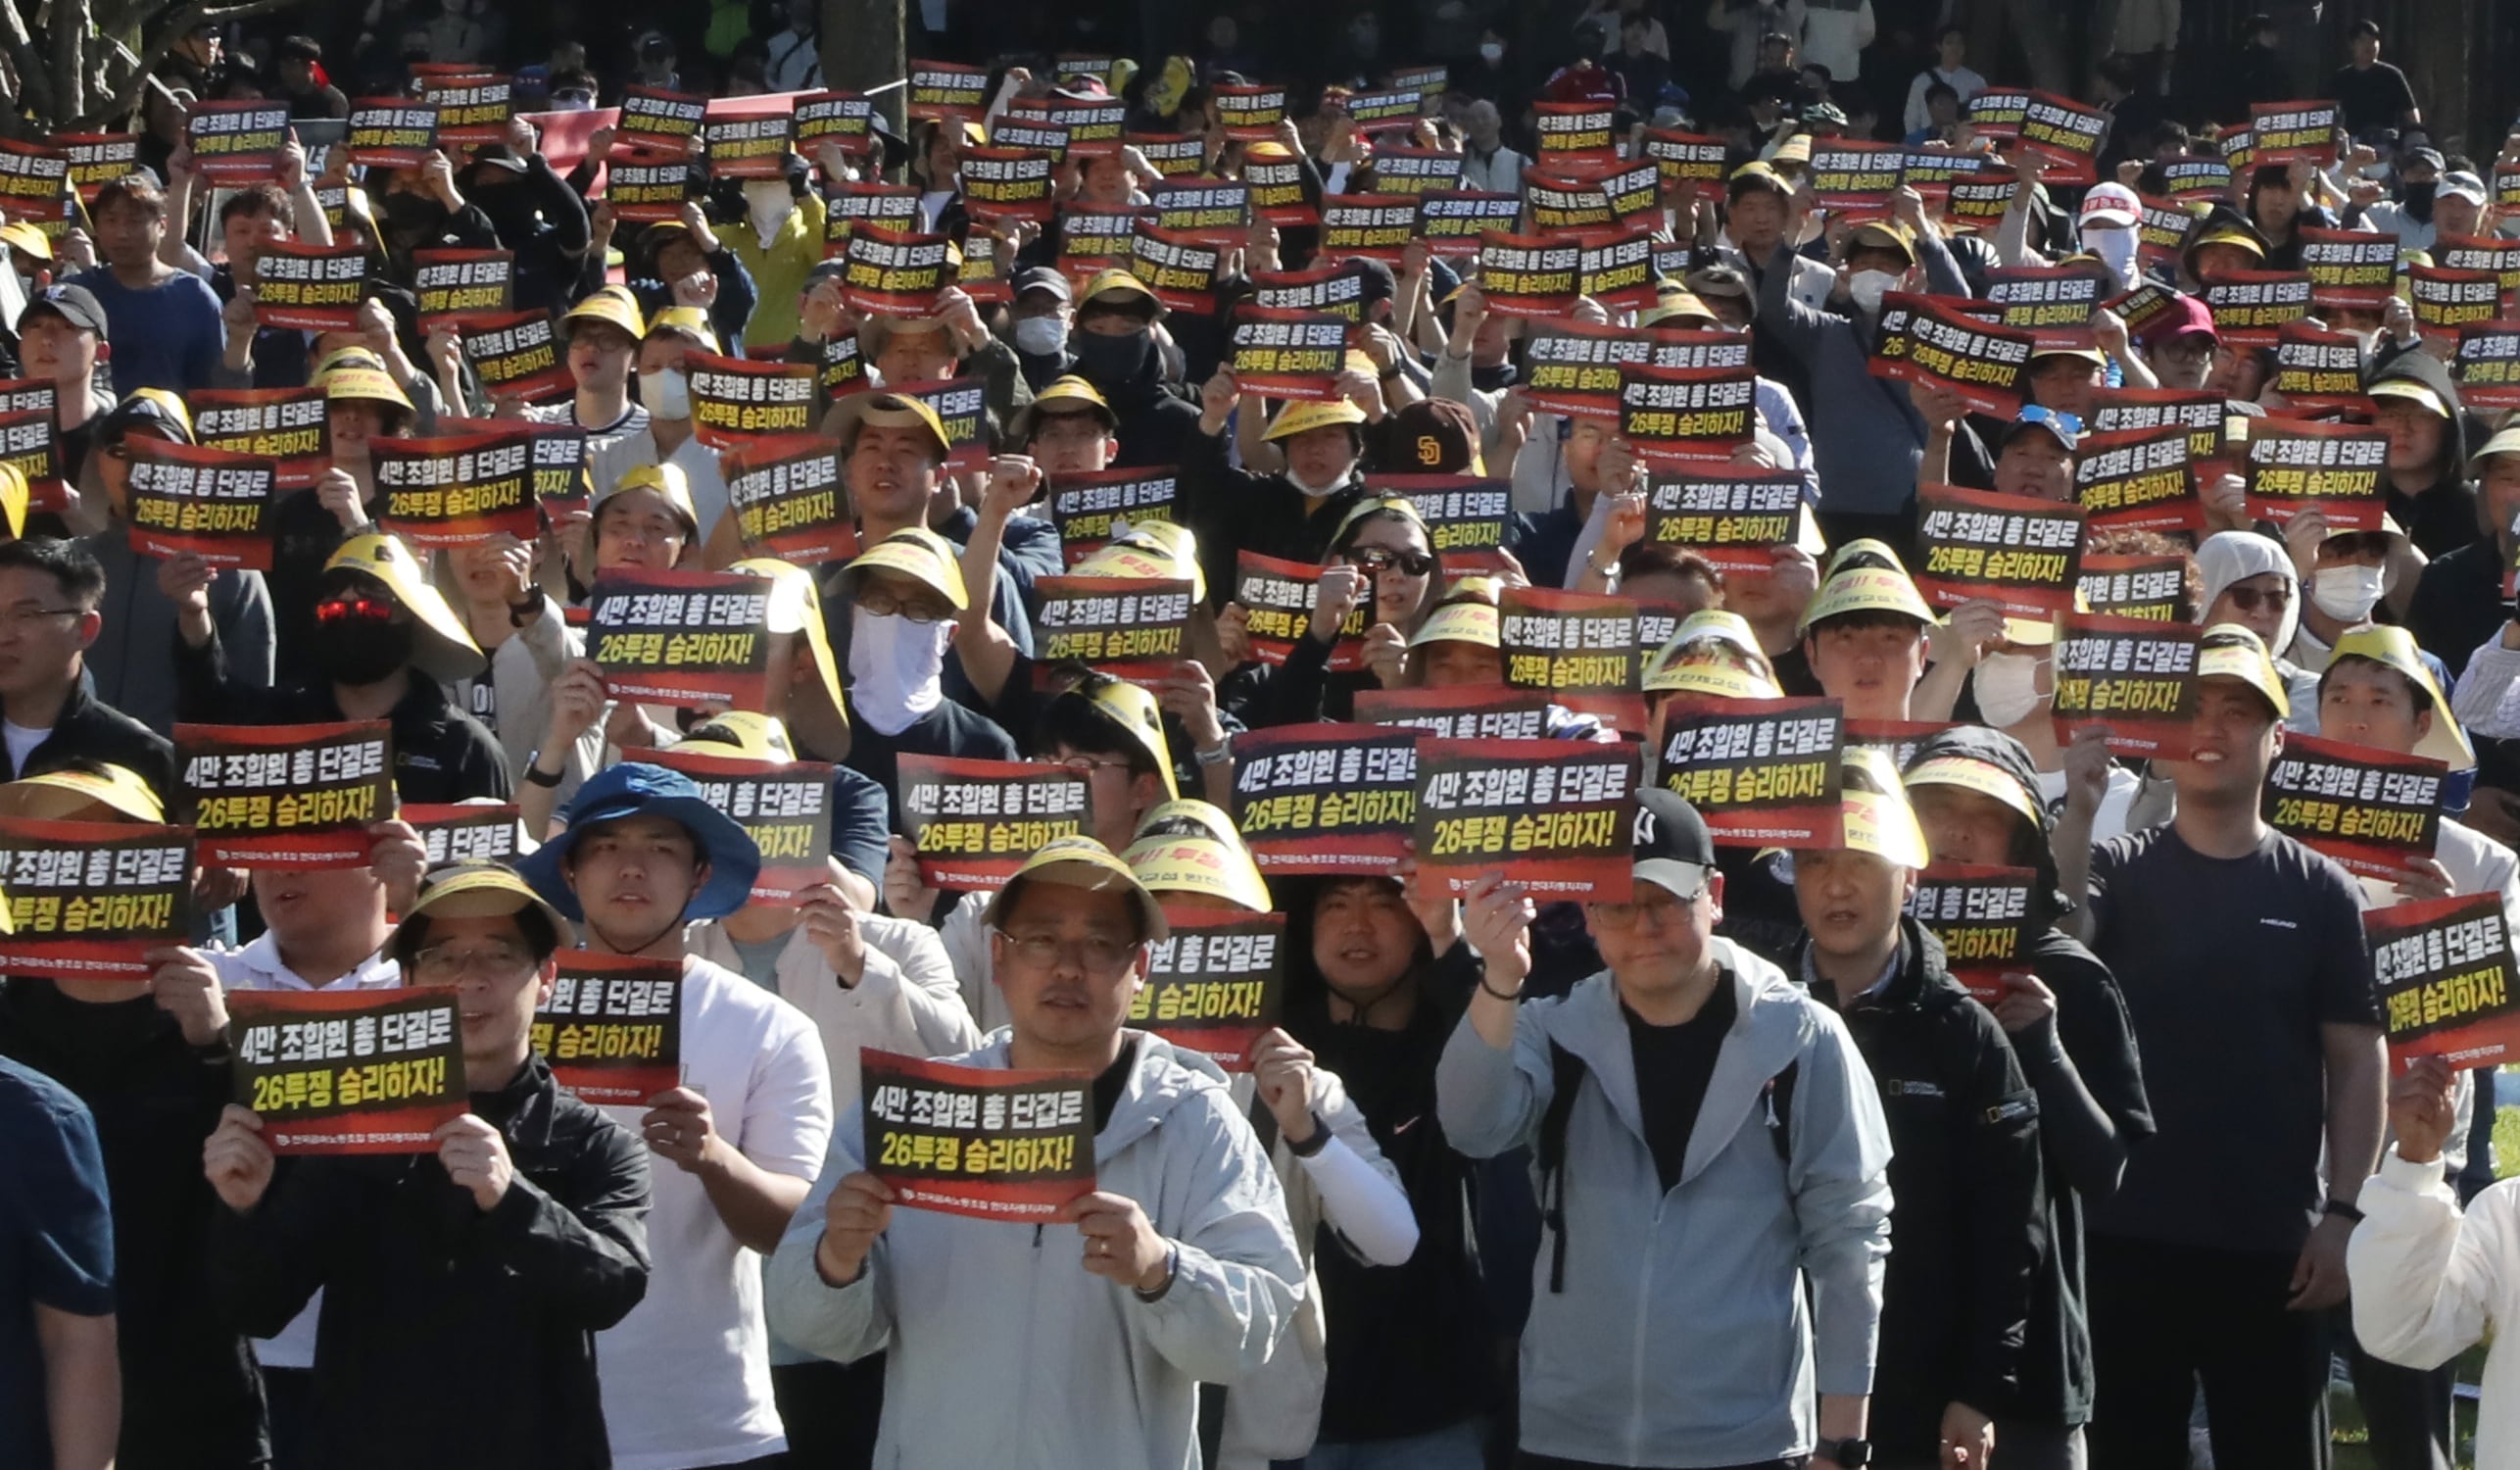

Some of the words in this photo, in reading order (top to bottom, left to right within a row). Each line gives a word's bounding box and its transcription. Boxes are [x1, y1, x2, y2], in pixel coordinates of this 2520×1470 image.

[379, 461, 404, 484] 4만
[407, 458, 454, 485] 조합원
[457, 455, 473, 481] 총
[477, 445, 525, 477] 단결로
[2251, 439, 2276, 463] 4만
[2276, 439, 2321, 465] 조합원
[2321, 440, 2339, 465] 총
[2340, 441, 2385, 465] 단결로
[129, 463, 151, 490] 4만
[152, 465, 195, 494] 조합원
[196, 467, 215, 496] 총
[216, 469, 268, 497] 단결로
[389, 491, 442, 515] 26투쟁
[445, 478, 520, 515] 승리하자!
[1652, 484, 1680, 510] 4만
[1681, 483, 1729, 510] 조합원
[1730, 484, 1749, 510] 총
[1750, 485, 1797, 510] 단결로
[2255, 469, 2305, 494] 26투쟁
[2305, 470, 2376, 495] 승리하자!
[179, 503, 259, 530] 승리하자!
[1657, 516, 1713, 541] 26투쟁
[1715, 515, 1788, 542] 승리하자!
[1923, 511, 1953, 538] 4만
[1952, 513, 2005, 542] 조합원
[2004, 515, 2024, 544] 총
[2024, 518, 2078, 547] 단결로
[1927, 546, 1985, 576] 26투쟁
[1984, 551, 2066, 581] 승리하자!
[596, 596, 629, 625] 4만
[627, 594, 685, 624] 조합원
[685, 594, 707, 625] 총
[708, 594, 766, 624] 단결로
[1040, 600, 1068, 626] 4만
[1069, 597, 1118, 624] 조합원
[1120, 596, 1138, 623] 총
[1139, 594, 1188, 621] 단결로
[596, 634, 663, 663] 26투쟁
[665, 633, 754, 663] 승리하자!
[1045, 632, 1102, 659] 26투쟁
[1106, 627, 1181, 657] 승리하자!
[1504, 615, 1522, 645] 4만
[1523, 616, 1562, 648] 조합원
[1564, 617, 1580, 649] 총
[1583, 618, 1631, 648] 단결로
[1510, 655, 1549, 685] 26투쟁
[1552, 656, 1626, 687] 승리하자!
[1666, 729, 1696, 763] 4만
[1693, 723, 1753, 759] 조합원
[1753, 721, 1775, 757] 총
[1776, 717, 1835, 755] 단결로
[185, 756, 221, 787] 4만
[224, 753, 287, 787] 조합원
[292, 749, 314, 784] 총
[318, 741, 383, 781] 단결로
[1238, 760, 1272, 792] 4만
[1272, 749, 1336, 786] 조합원
[1339, 747, 1362, 782] 총
[1735, 761, 1825, 802] 승리하자!
[2271, 760, 2303, 789] 4만
[2303, 763, 2360, 797] 조합원
[2359, 770, 2382, 800] 총
[2382, 773, 2439, 805] 단결로
[906, 784, 940, 814] 4만
[943, 784, 999, 814] 조합원
[1003, 783, 1023, 813] 총
[1027, 782, 1084, 812] 단결로
[1424, 772, 1461, 808] 4만
[1462, 768, 1528, 806] 조합원
[1531, 765, 1556, 803] 총
[1559, 764, 1627, 802] 단결로
[196, 796, 270, 828] 26투쟁
[276, 784, 375, 826] 승리하자!
[1241, 794, 1316, 832] 26투쟁
[2273, 798, 2339, 831] 26투쟁
[2340, 806, 2425, 842] 승리하자!
[917, 823, 985, 852] 26투쟁
[1431, 815, 1507, 854] 26투쟁
[1510, 810, 1616, 851] 승리하자!
[13, 850, 84, 886] 조합원
[85, 849, 112, 886] 총
[115, 847, 186, 885] 단결로
[12, 896, 61, 931] 투쟁
[64, 893, 173, 932] 승리하자!
[1179, 935, 1203, 973] 총
[1206, 935, 1275, 971] 단결로
[2427, 928, 2444, 971] 총
[2446, 915, 2504, 966] 단결로
[578, 978, 604, 1015] 총
[606, 980, 675, 1016] 단결로
[1157, 981, 1263, 1019] 승리하자!
[2423, 965, 2507, 1024] 승리하자!
[240, 1025, 276, 1063] 4만
[280, 1019, 347, 1060] 조합원
[354, 1016, 375, 1055] 총
[381, 1007, 451, 1052] 단결로
[557, 1024, 662, 1058] 승리하자!
[253, 1069, 331, 1110] 26투쟁
[338, 1056, 444, 1104] 승리하자!
[871, 1086, 907, 1121] 4만
[910, 1090, 977, 1128] 조합원
[983, 1094, 1005, 1129] 총
[1011, 1091, 1082, 1128] 단결로
[881, 1132, 958, 1170] 26투쟁
[965, 1135, 1074, 1172] 승리하자!
